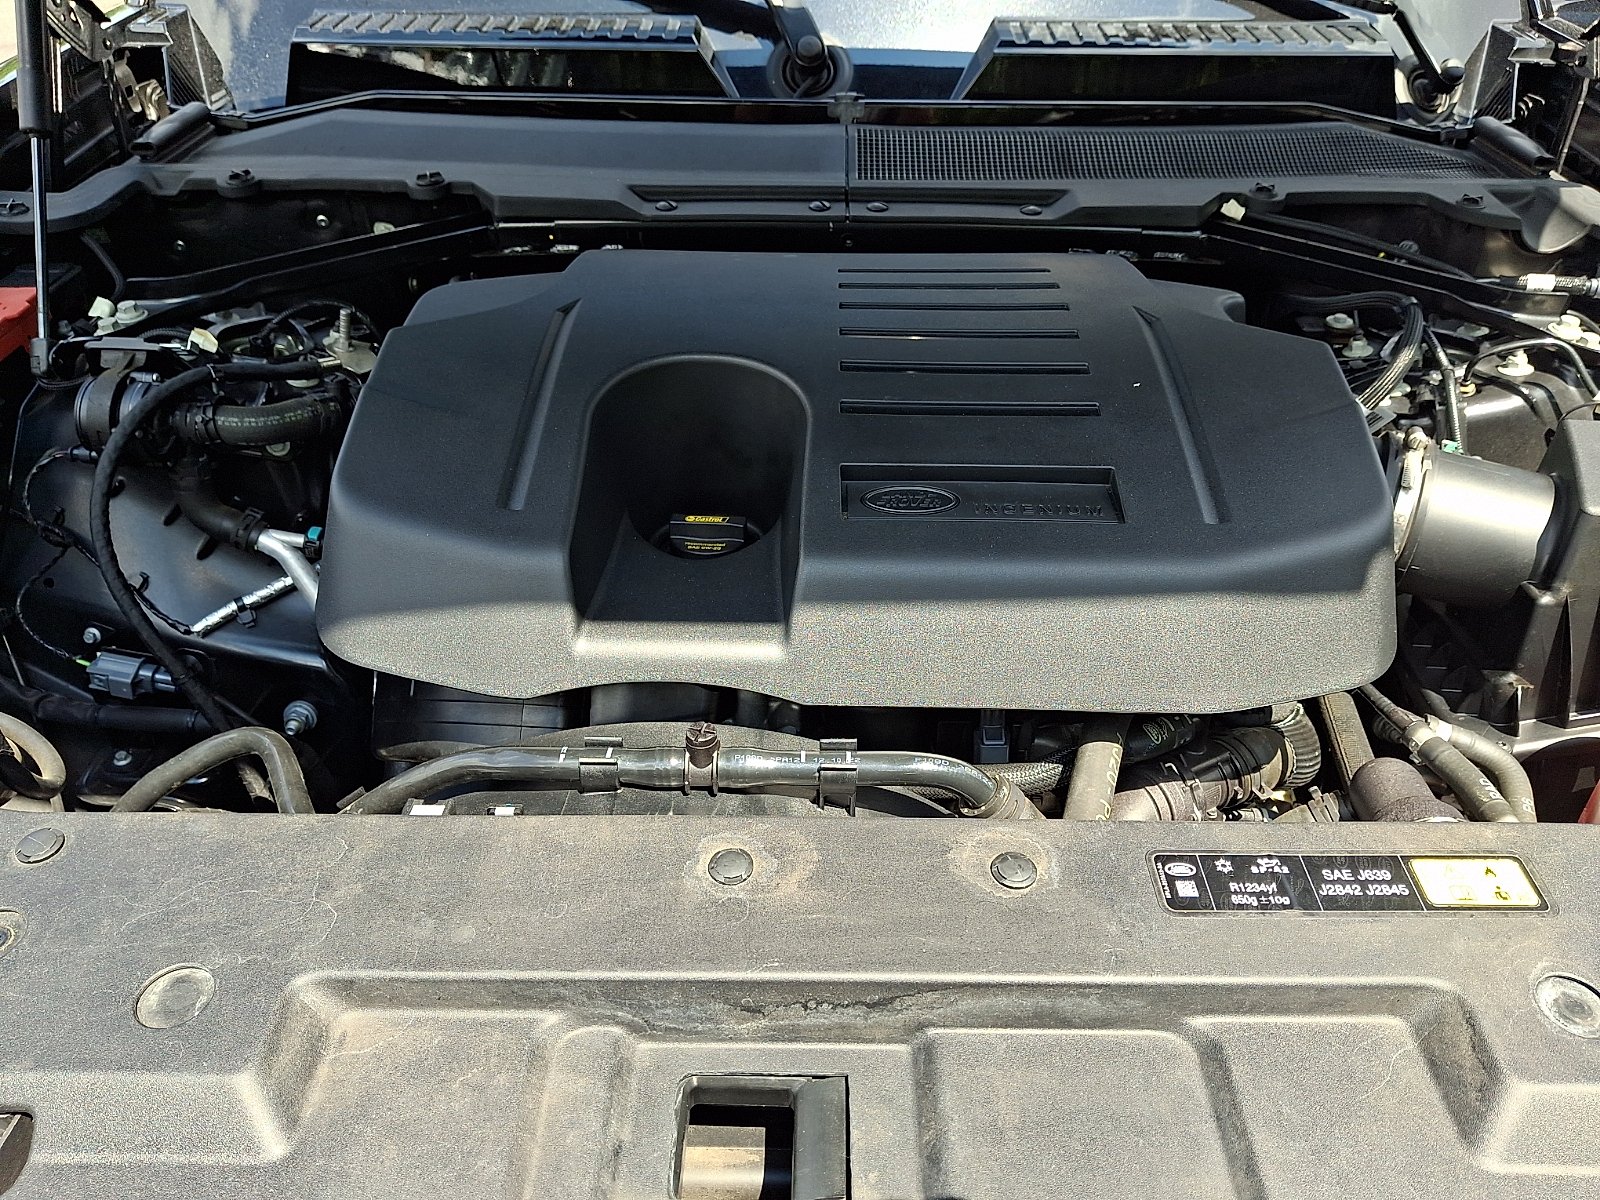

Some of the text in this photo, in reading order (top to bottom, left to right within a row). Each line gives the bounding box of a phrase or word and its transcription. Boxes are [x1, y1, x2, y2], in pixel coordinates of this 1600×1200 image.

[974, 503, 1104, 517] INGENIUM
[694, 515, 724, 523] Castrol
[1321, 869, 1392, 881] SAE J639
[1229, 881, 1278, 895] R1234yf
[1319, 883, 1410, 896] J2842 J2845
